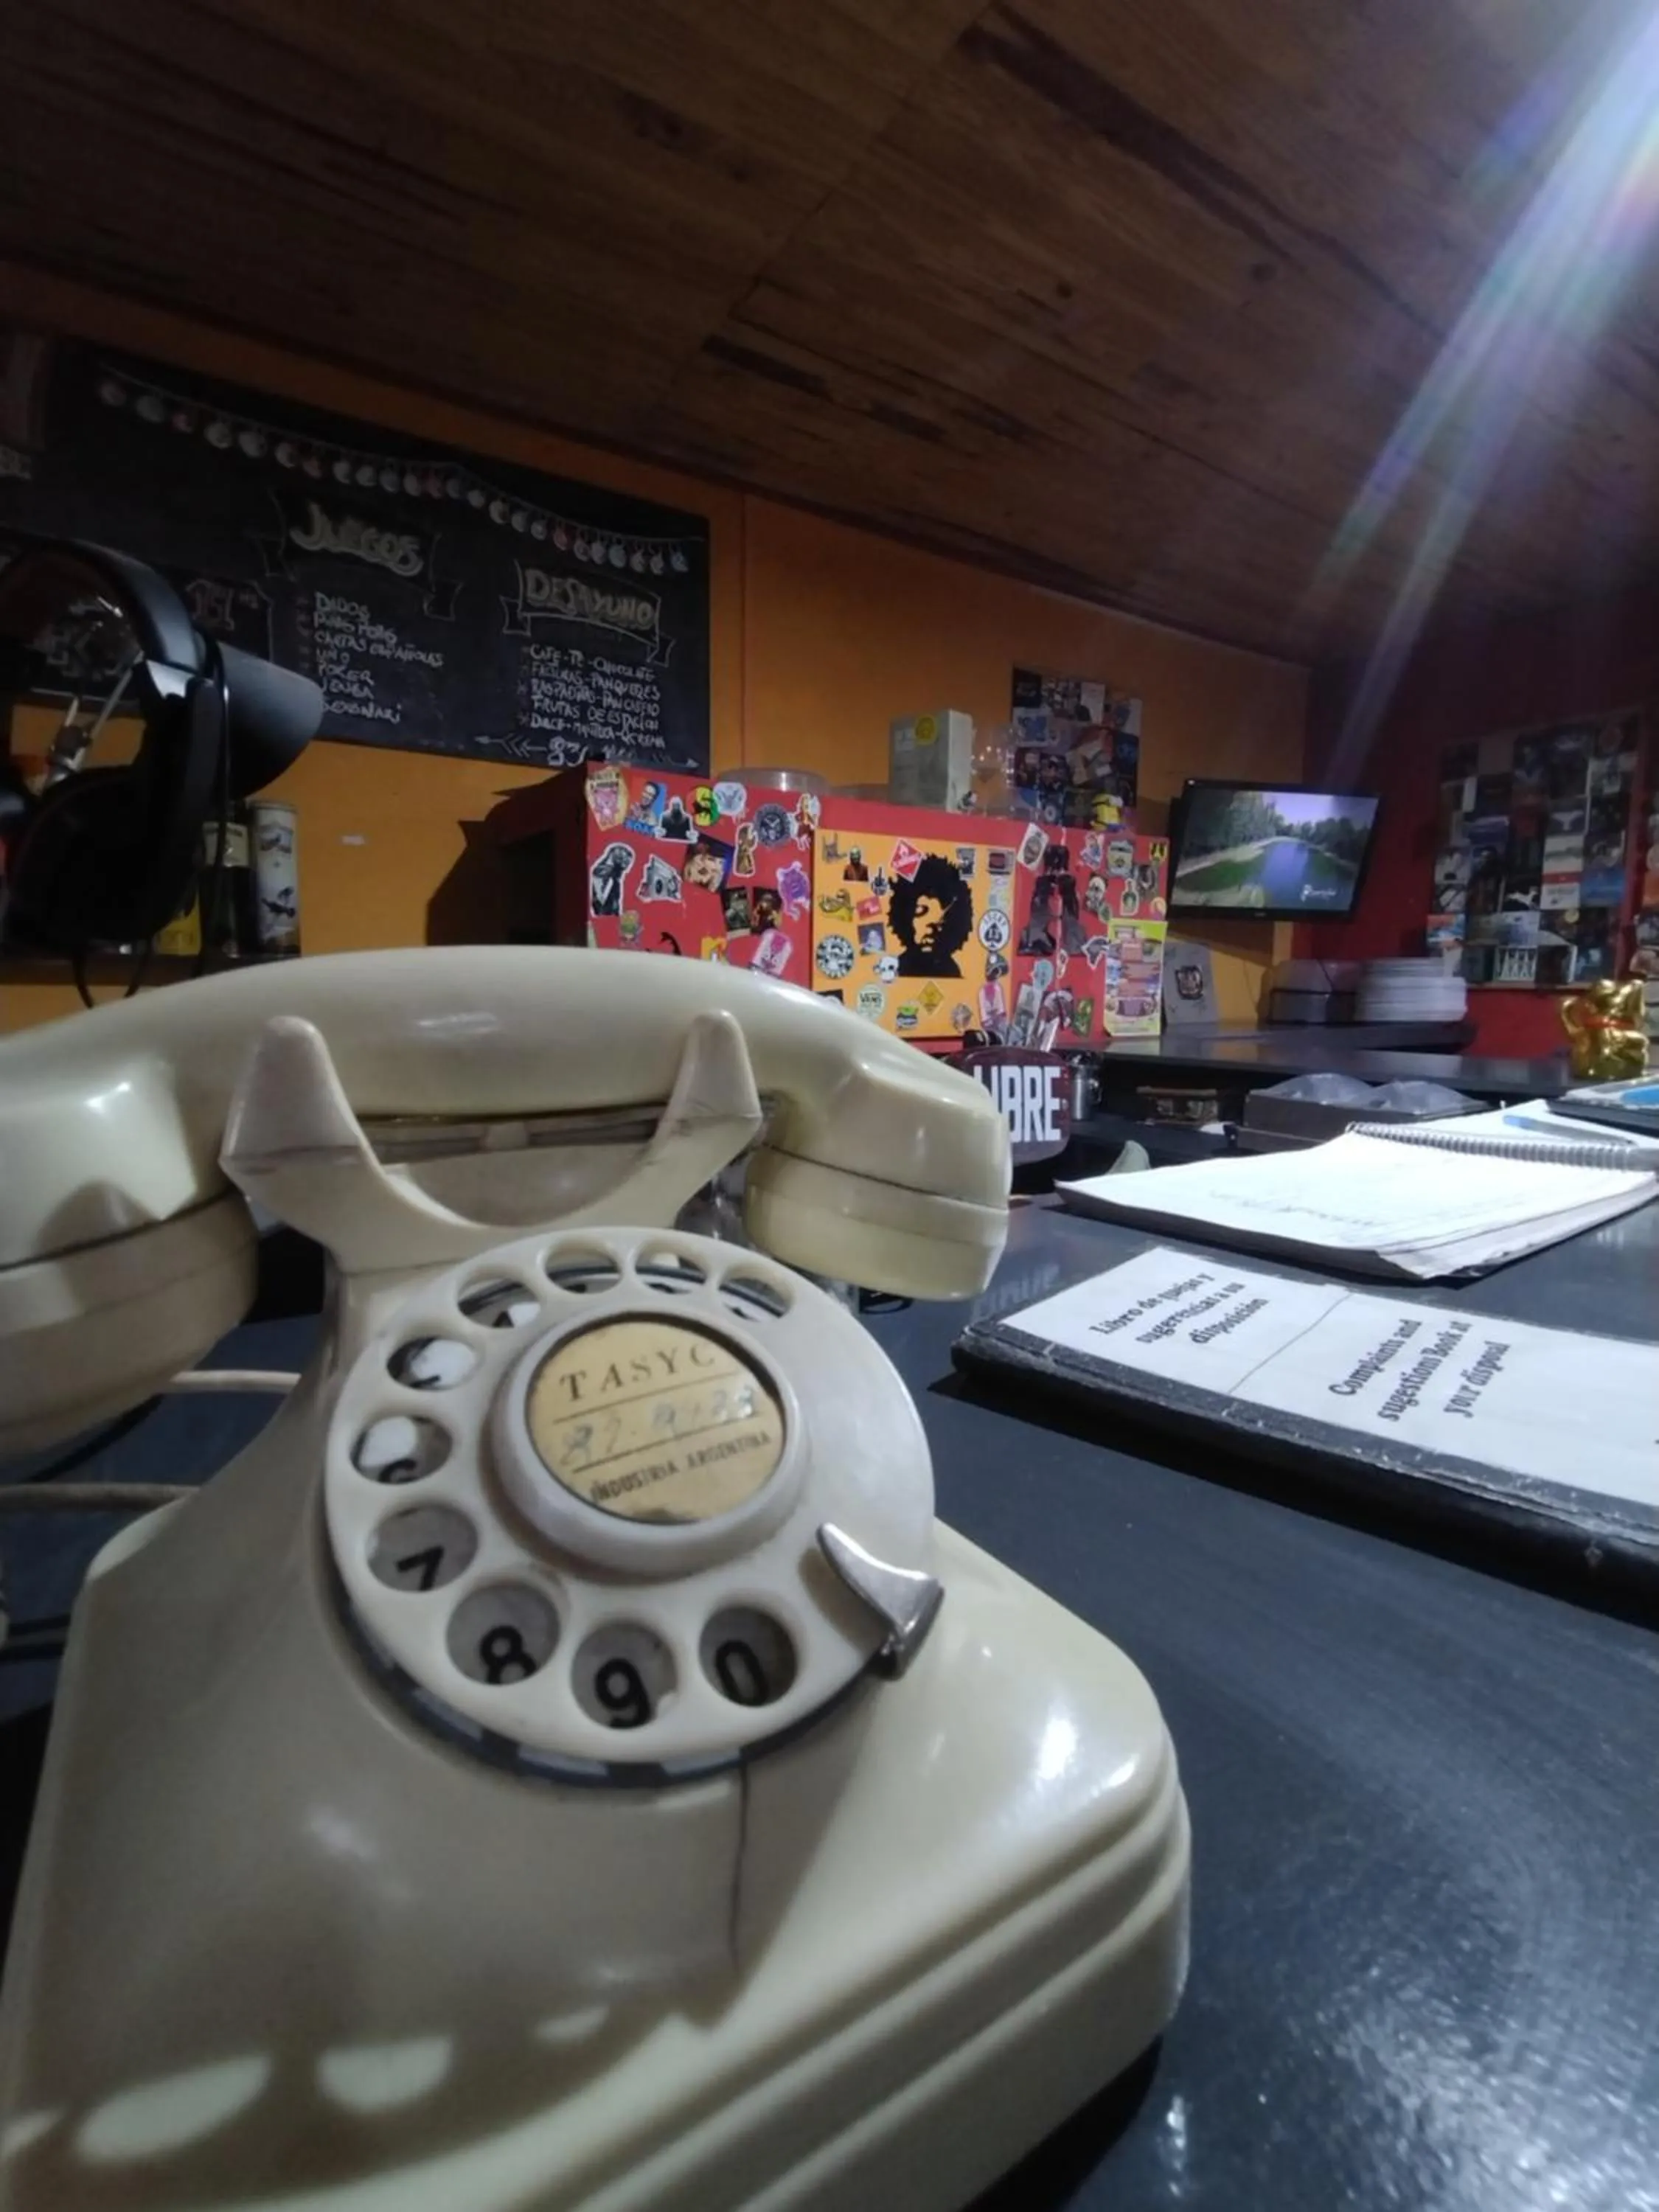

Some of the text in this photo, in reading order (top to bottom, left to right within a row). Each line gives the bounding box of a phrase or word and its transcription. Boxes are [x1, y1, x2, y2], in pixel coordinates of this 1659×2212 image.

[289, 501, 424, 577] JUEGOS
[525, 568, 655, 630] DESAYUNO
[973, 1065, 1061, 1142] IBRE
[1088, 1308, 1144, 1335] Libro
[1419, 1330, 1464, 1357] Book
[1328, 1318, 1423, 1397] Complaints and
[1443, 1340, 1511, 1419] your disposal
[590, 1430, 772, 1502] INDUSTRIA ARGENTINA
[395, 1546, 444, 1591] 7
[479, 1625, 538, 1686] 8
[715, 1639, 771, 1706] 0
[594, 1659, 653, 1729] 9
